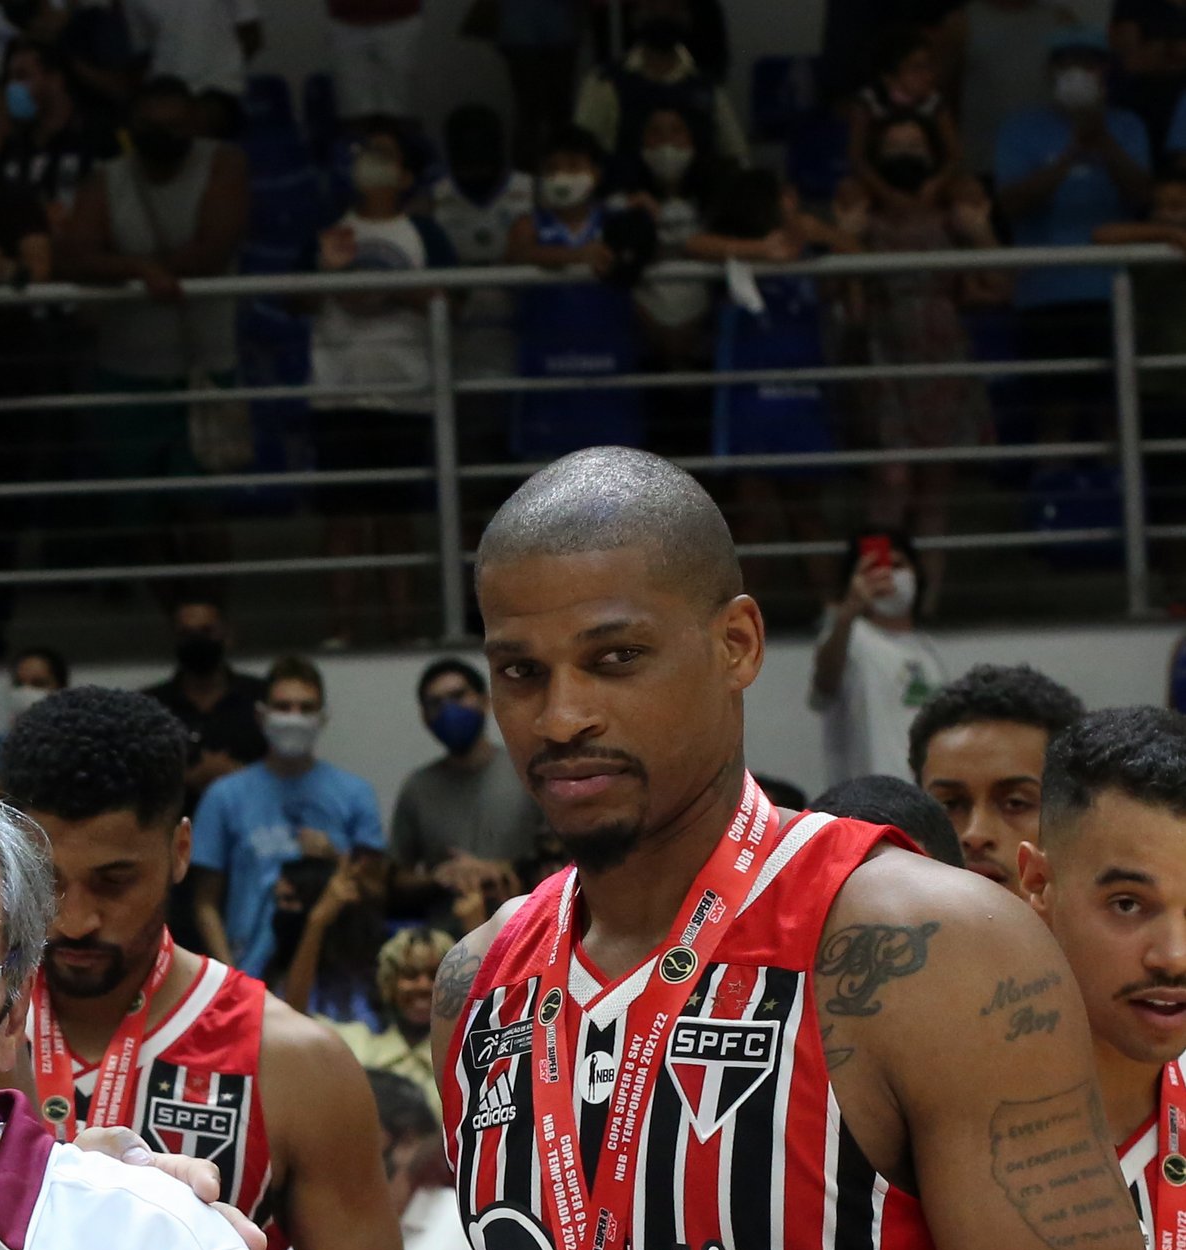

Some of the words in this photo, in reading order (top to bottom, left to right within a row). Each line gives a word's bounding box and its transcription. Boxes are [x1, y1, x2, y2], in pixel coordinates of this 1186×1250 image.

[727, 812, 750, 843] COPA
[733, 848, 756, 874] NBB
[689, 896, 715, 928] SUPER
[703, 887, 719, 902] 8
[706, 896, 727, 924] SKY
[627, 1033, 645, 1060] SKY
[674, 1028, 766, 1058] SPFC
[546, 1045, 558, 1074] SUPER
[624, 1060, 636, 1071] 8
[596, 1068, 614, 1084] NBB
[613, 1153, 628, 1182] NBB
[621, 1066, 649, 1144] TEMPORADA
[639, 1011, 669, 1066] 2021/22
[614, 1072, 633, 1114] SUPER
[158, 1107, 228, 1133] SPFC
[472, 1104, 517, 1130] adidas
[541, 1114, 555, 1141] NBB
[606, 1116, 623, 1151] COPA
[559, 1134, 575, 1169] COPA
[546, 1148, 571, 1223] TEMPORADA
[564, 1169, 583, 1211] SUPER
[574, 1212, 586, 1222] 8
